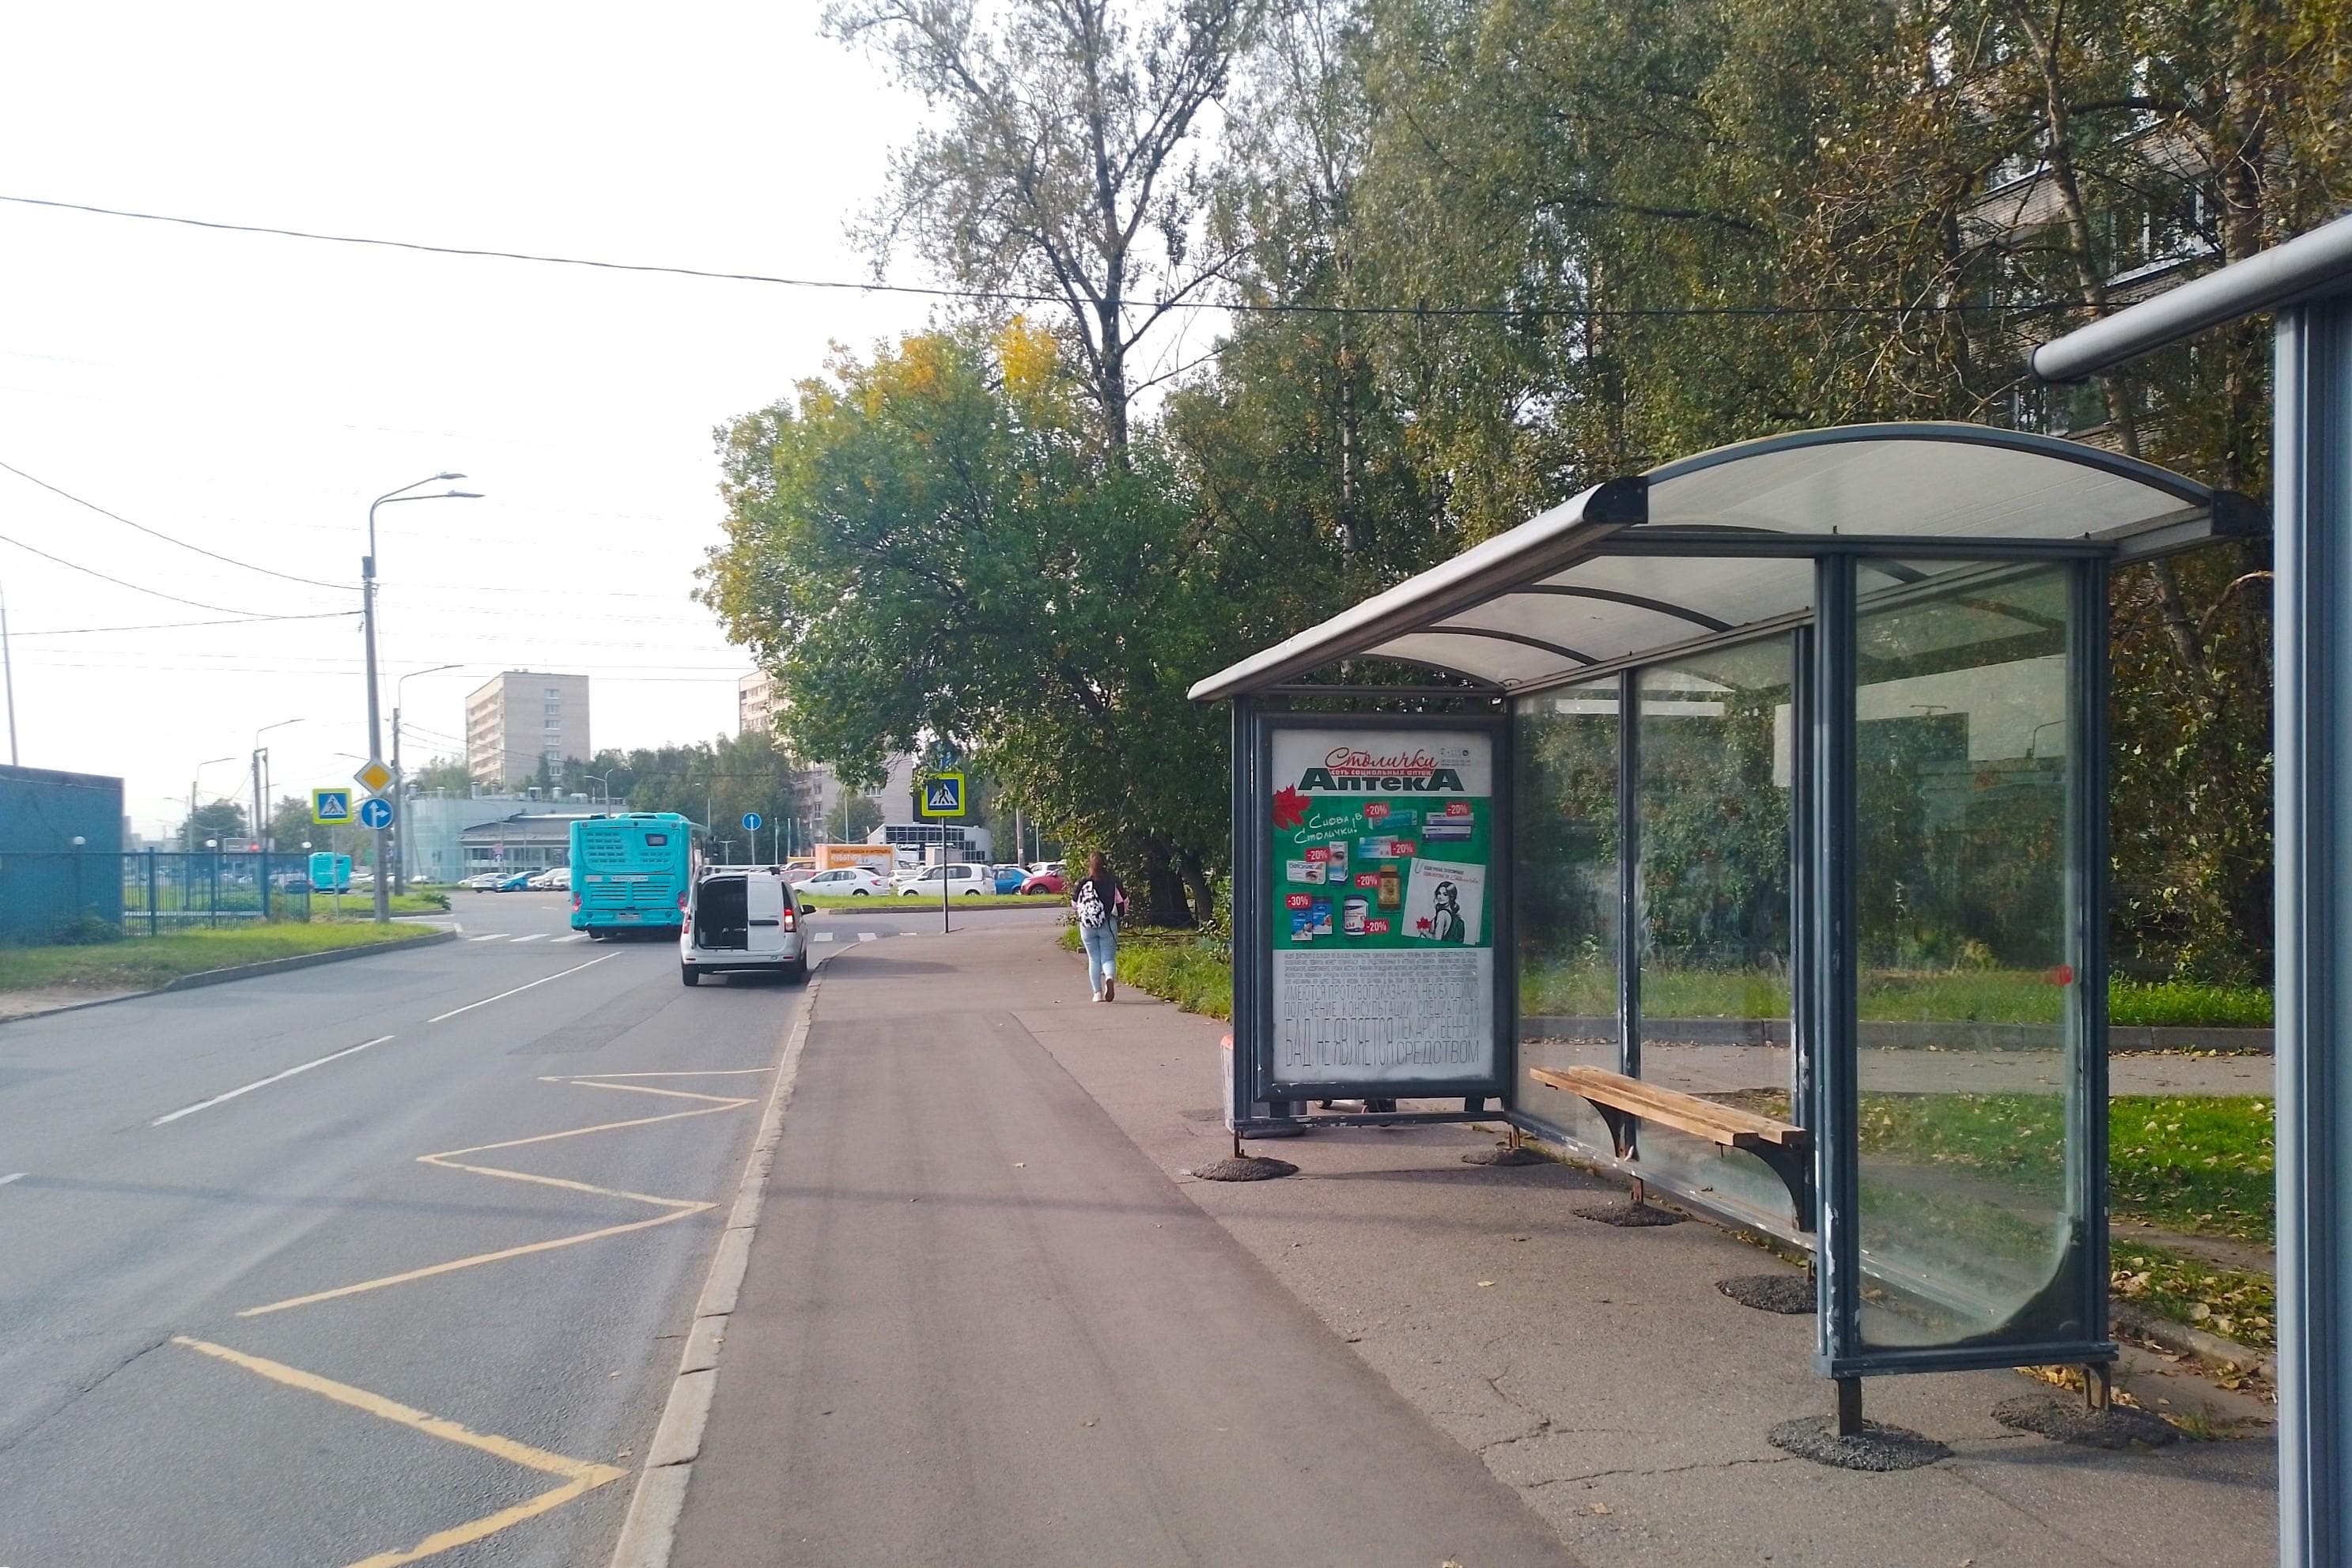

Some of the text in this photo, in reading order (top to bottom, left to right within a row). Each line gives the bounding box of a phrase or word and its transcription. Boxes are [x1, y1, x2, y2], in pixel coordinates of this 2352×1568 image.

[1325, 746, 1439, 768] Столички
[1366, 804, 1387, 815] -20%
[1448, 804, 1469, 814] -20%
[1392, 843, 1413, 854] -20%
[1306, 849, 1328, 860] -20%
[1356, 875, 1378, 886] -20%
[1288, 896, 1309, 906] -30%
[1366, 921, 1387, 932] -20%
[1284, 984, 1326, 1000] ИМЕЮТСЯ
[1423, 982, 1479, 999] НЕОБХОДИМО
[1284, 999, 1480, 1018] ПОЛУЧЕНИЕ КОНСУЛЬТАЦИИ СПЕЦИАЛИСТА
[1397, 1015, 1479, 1040] ЛЕКАРСТВЕННЫМ
[1286, 1017, 1393, 1067] БАД НЕ ЯВЛЯЕТСЯ
[1397, 1039, 1479, 1066] СРЕДСТВОМ
